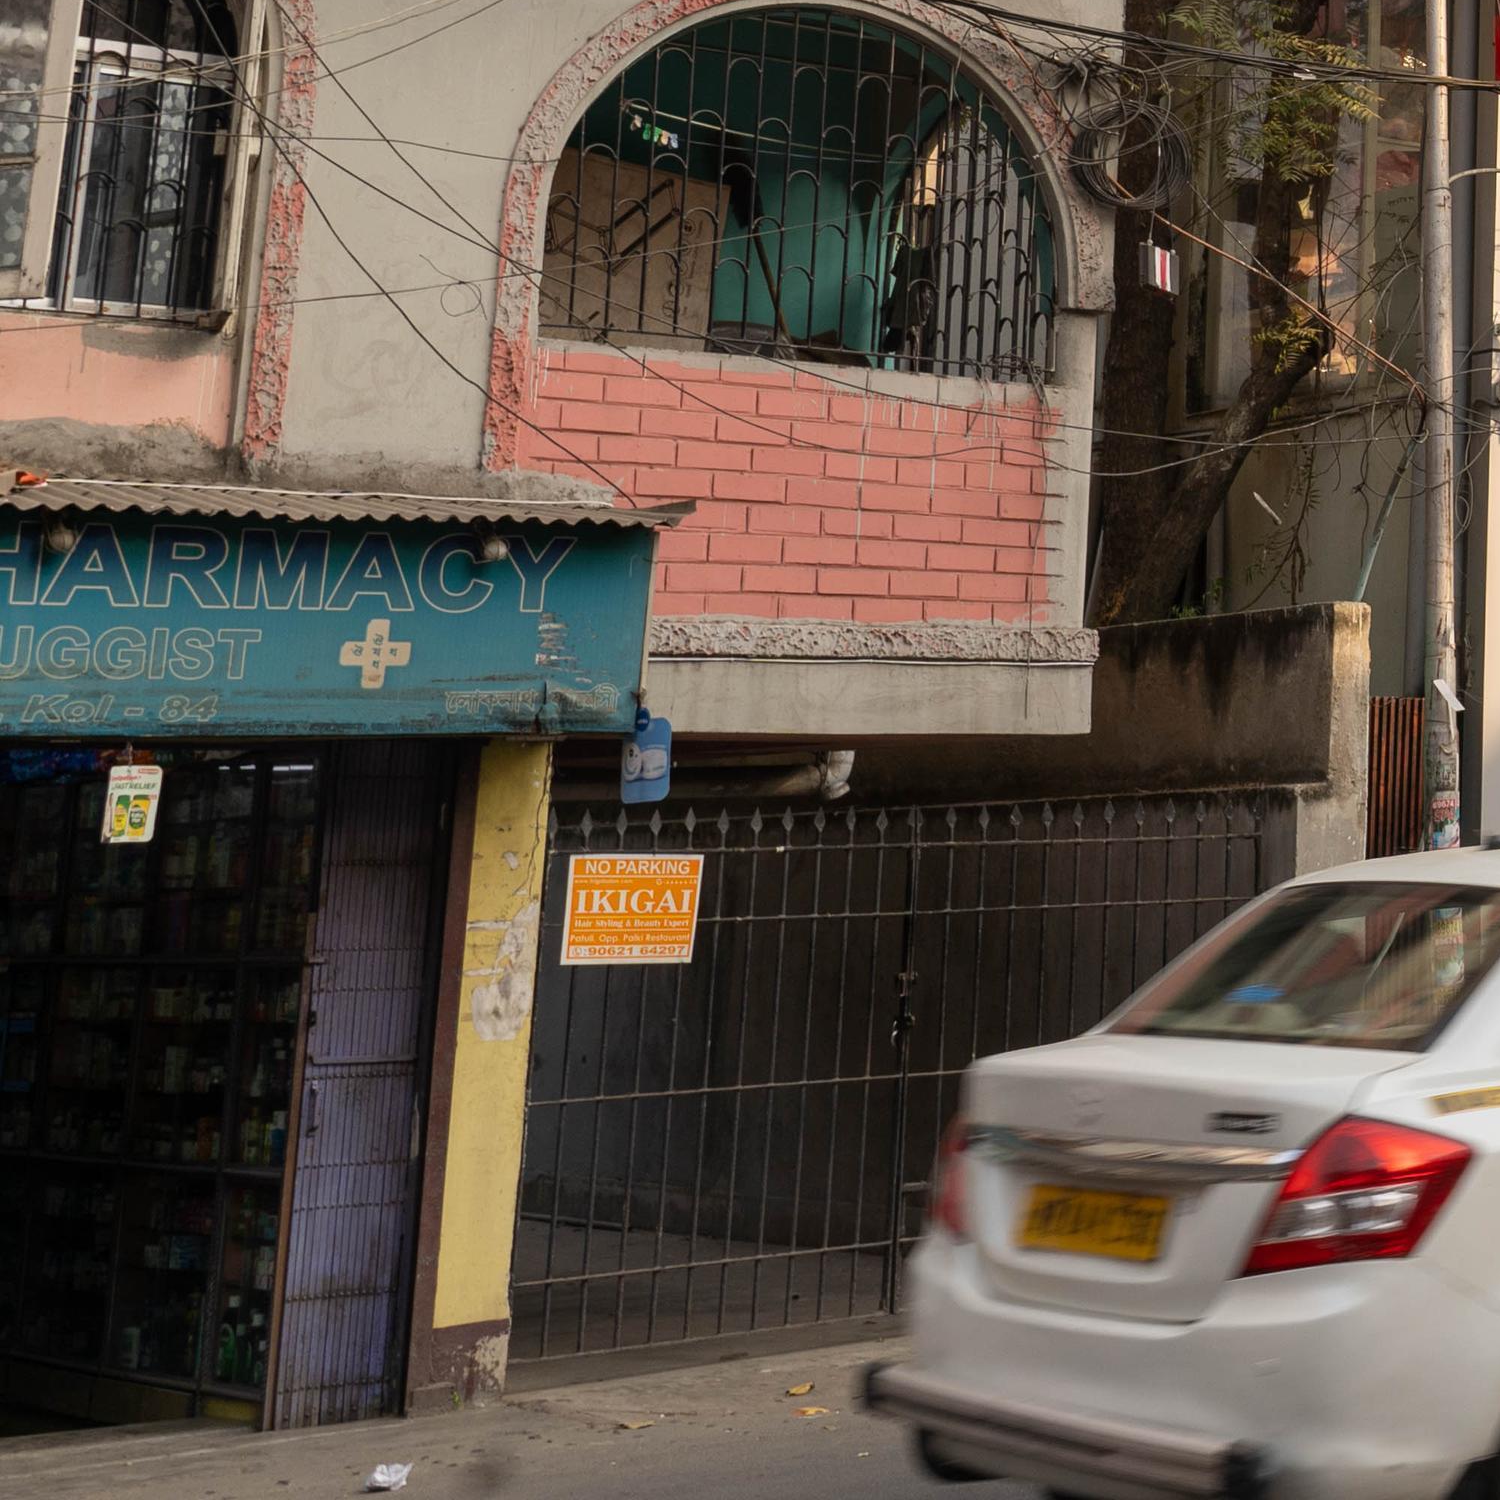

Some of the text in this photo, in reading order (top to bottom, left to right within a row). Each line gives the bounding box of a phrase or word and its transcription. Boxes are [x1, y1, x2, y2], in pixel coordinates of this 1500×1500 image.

[21, 695, 114, 723] Kol
[158, 695, 219, 723] 84
[585, 861, 690, 875] NO PARKING
[575, 889, 694, 914] IKIGAI
[575, 919, 689, 928] Hair Styling & Beauty Expert
[623, 933, 643, 942] Palki
[646, 933, 690, 942] Restaurant
[587, 946, 685, 956] 90621 64297
